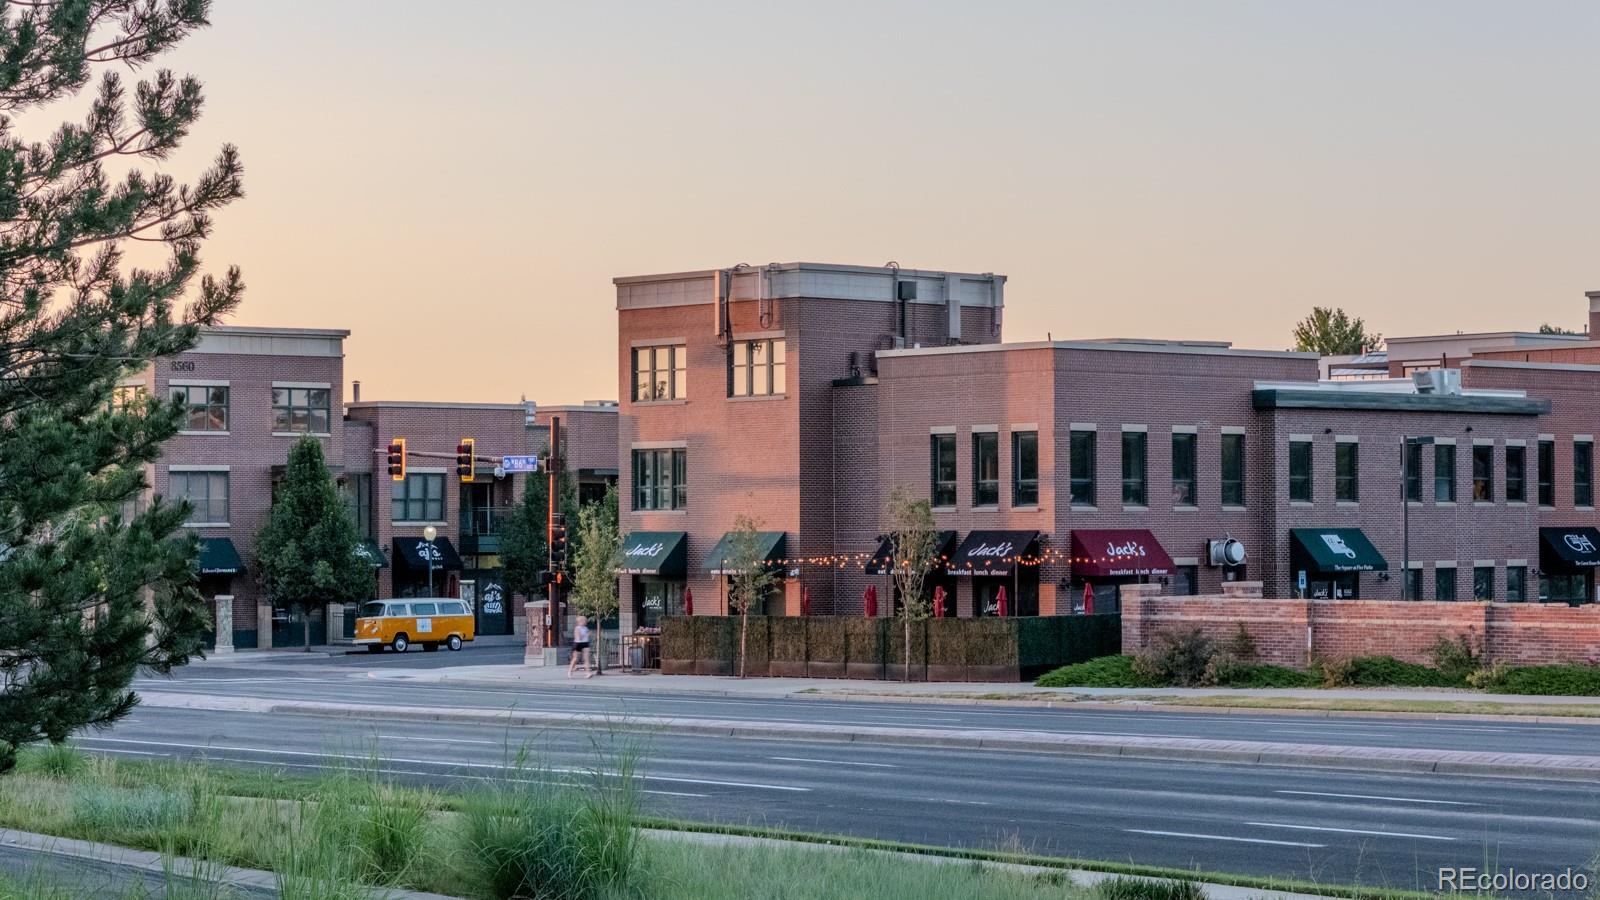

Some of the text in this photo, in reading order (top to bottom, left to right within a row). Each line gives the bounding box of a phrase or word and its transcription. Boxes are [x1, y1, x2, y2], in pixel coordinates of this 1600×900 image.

[626, 543, 663, 557] Jack's
[968, 542, 1013, 557] Jack's
[1107, 541, 1145, 556] Jack's
[947, 568, 972, 576] breakfast
[1109, 568, 1134, 576] breakfast
[642, 596, 661, 608] Jack's
